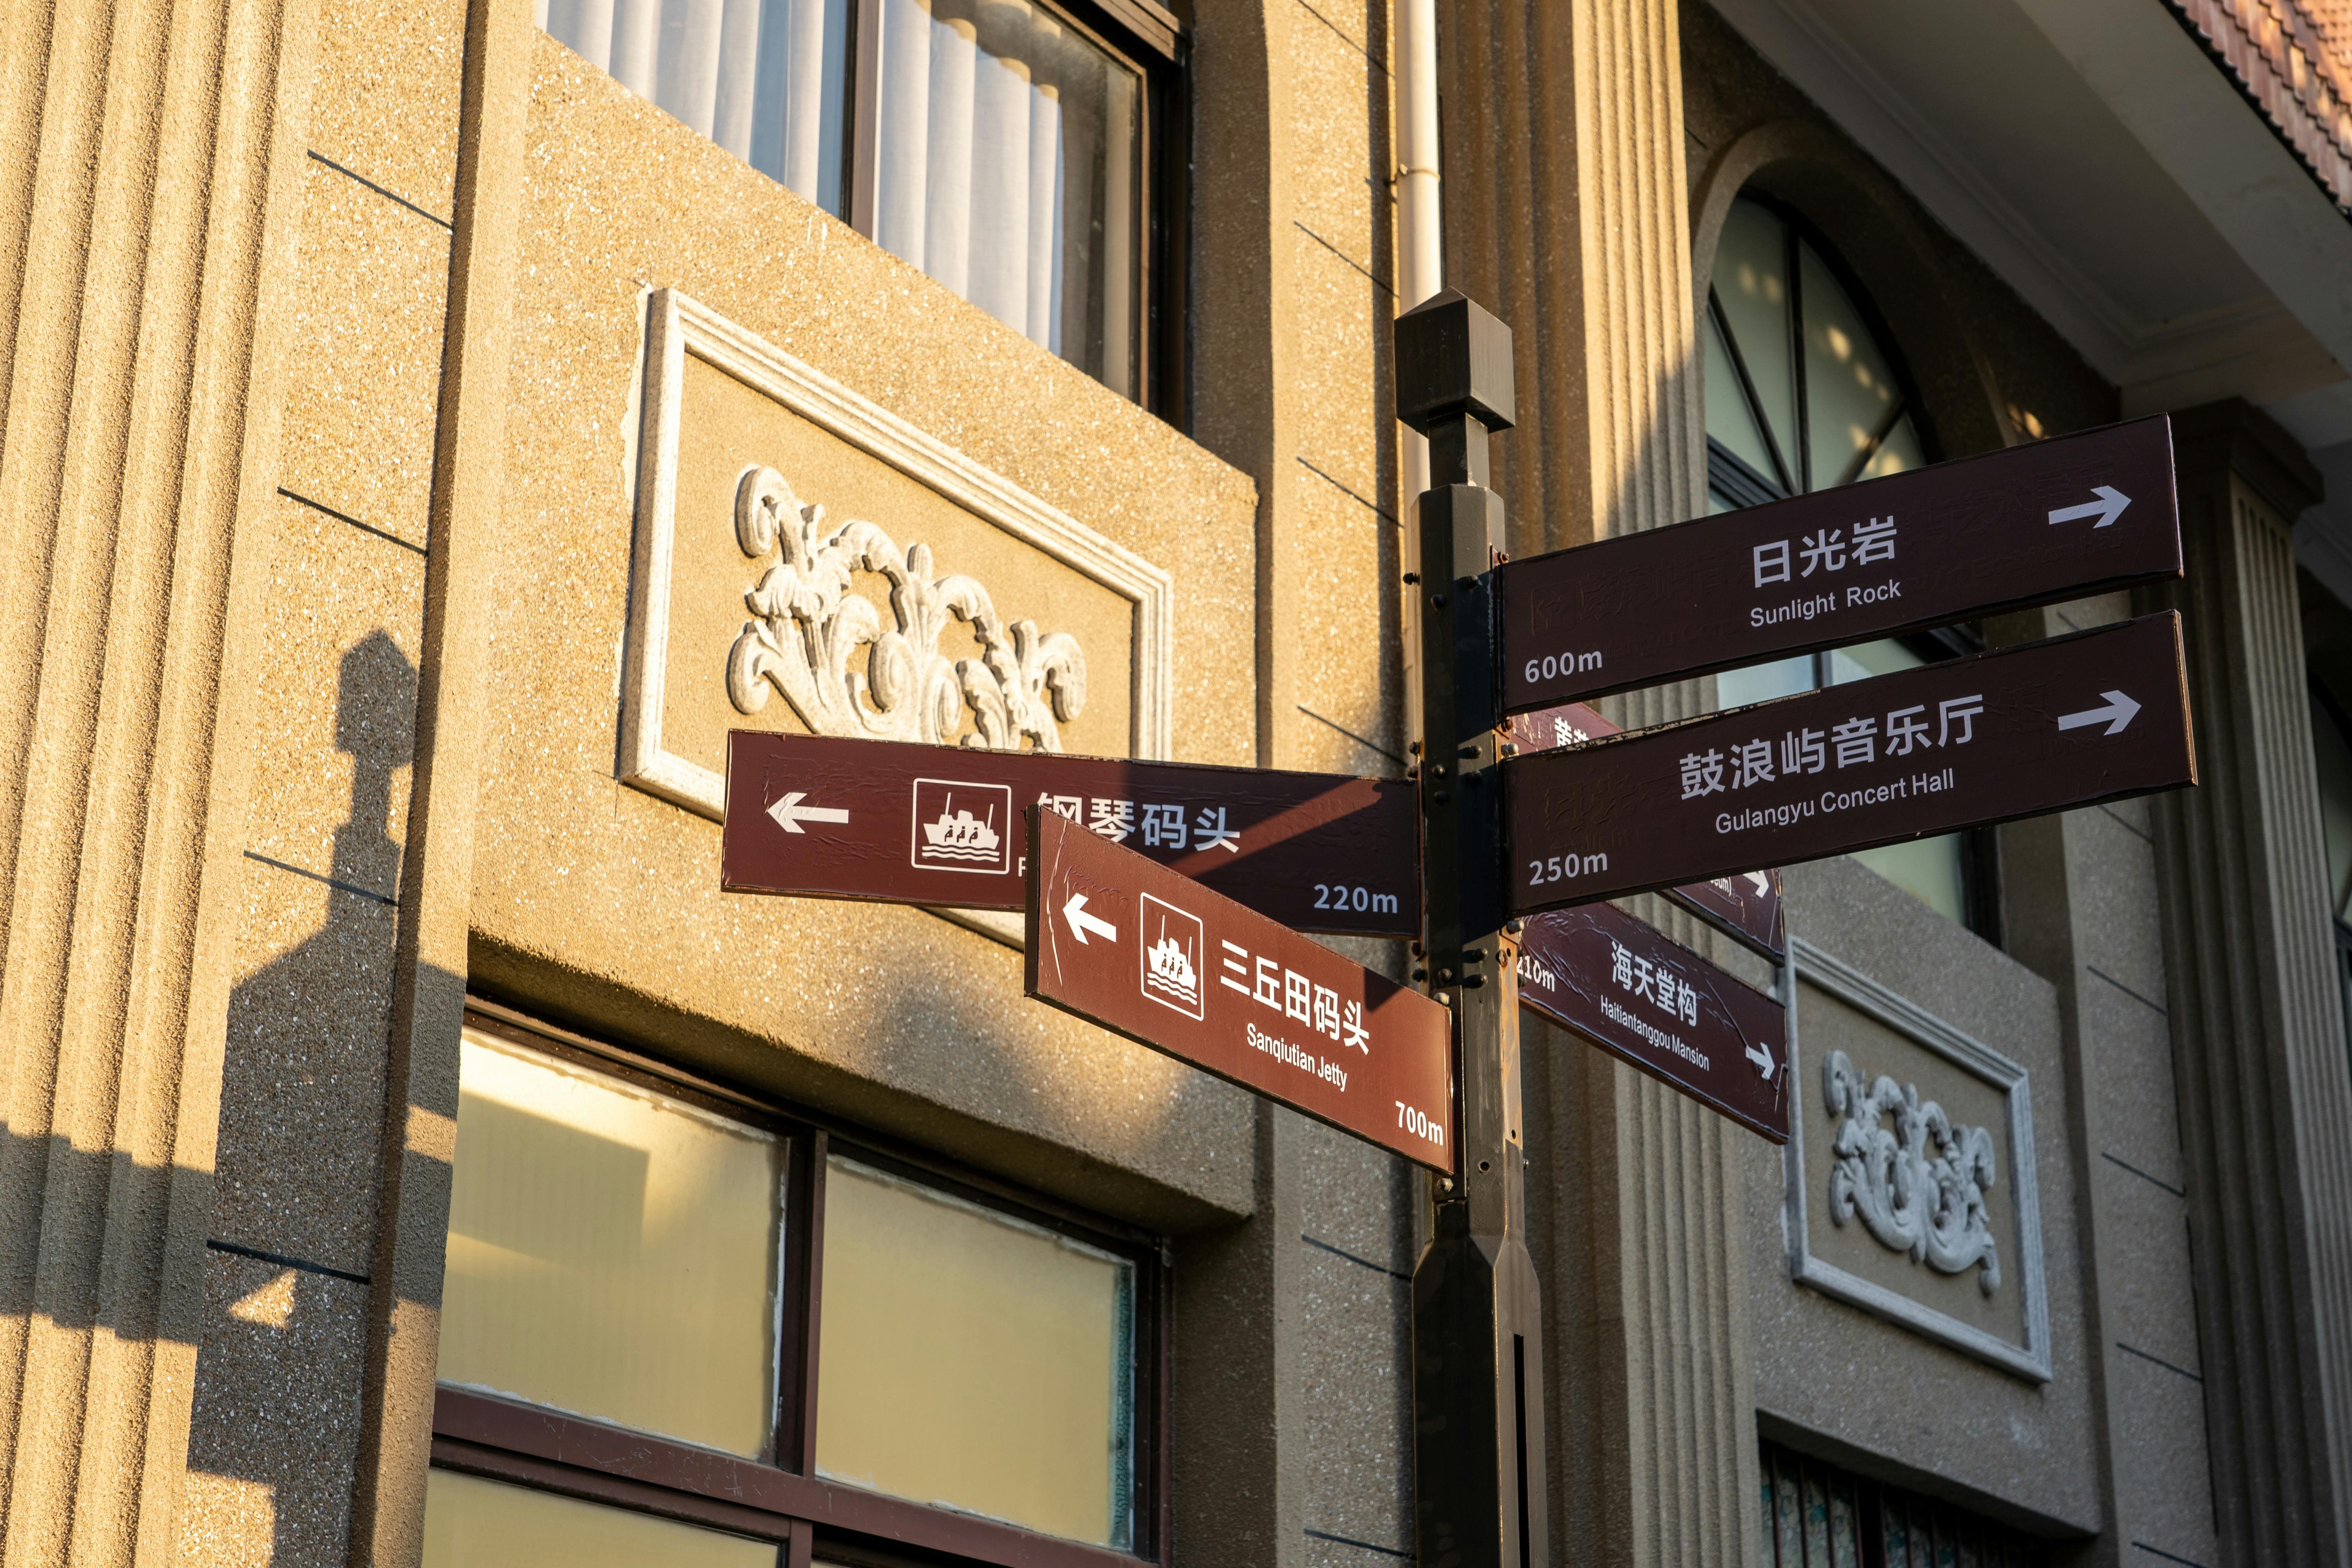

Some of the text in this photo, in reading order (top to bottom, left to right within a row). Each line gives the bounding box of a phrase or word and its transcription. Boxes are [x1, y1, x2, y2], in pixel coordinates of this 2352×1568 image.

[1754, 516, 1897, 587] 日光岩
[1751, 580, 1900, 626] Sunlight Rock
[1526, 652, 1602, 682] 600m
[1680, 694, 1983, 800] 鼓浪屿音乐厅
[1716, 768, 1953, 833] Gulangyu Concert Hall
[1315, 885, 1396, 912] 220m
[1530, 853, 1607, 885] 250m
[1221, 940, 1368, 1055] 三丘田码头
[1612, 941, 1696, 1027] 海天堂构
[1248, 1023, 1347, 1092] Sanqiutian Jetty
[1601, 996, 1709, 1071] Haitiantanggou Mansion
[1396, 1101, 1443, 1145] 700m
